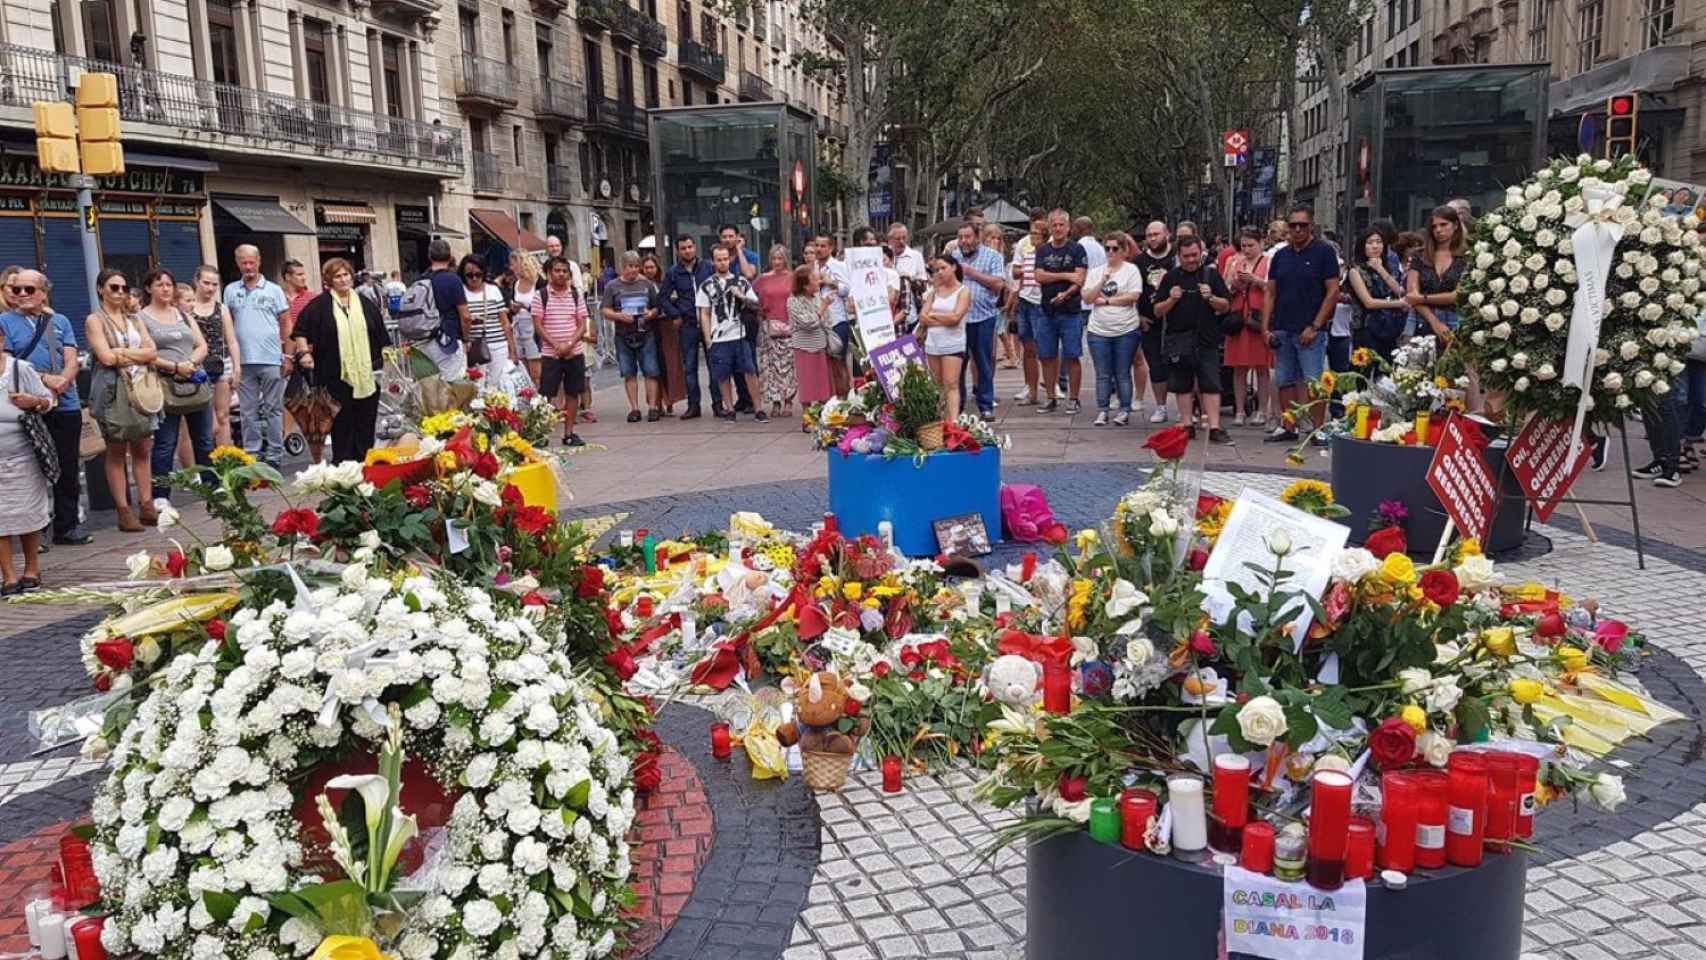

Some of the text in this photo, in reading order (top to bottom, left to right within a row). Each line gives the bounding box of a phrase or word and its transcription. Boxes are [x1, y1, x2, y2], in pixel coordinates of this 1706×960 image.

[1232, 889, 1337, 911] CASAL LA
[1233, 919, 1355, 945] DIANA 2018
